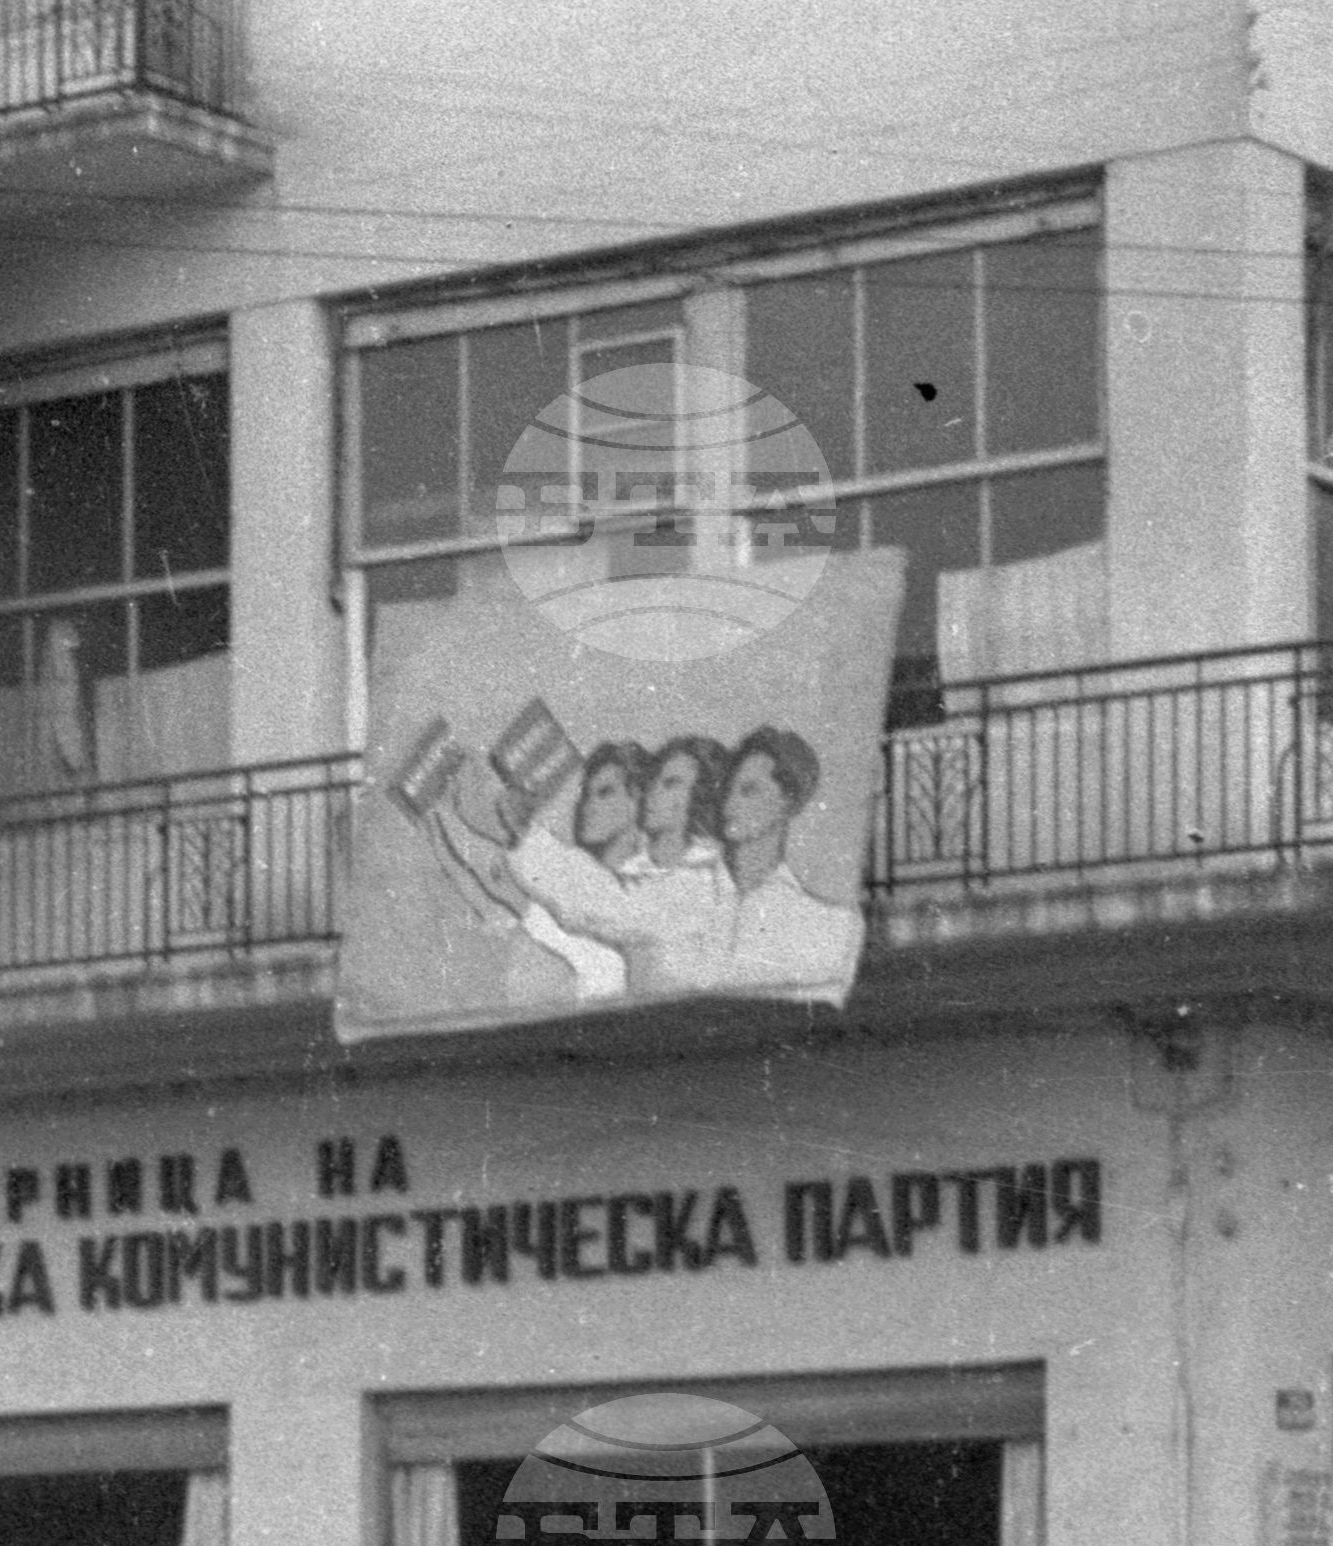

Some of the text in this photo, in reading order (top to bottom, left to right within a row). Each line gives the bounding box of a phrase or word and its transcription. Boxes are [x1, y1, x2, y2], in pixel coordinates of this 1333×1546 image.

[316, 1134, 409, 1200] НА
[77, 1184, 759, 1312] КОМУНИСТИЧЕСКА
[783, 1158, 1101, 1265] ПАРТИЯ
